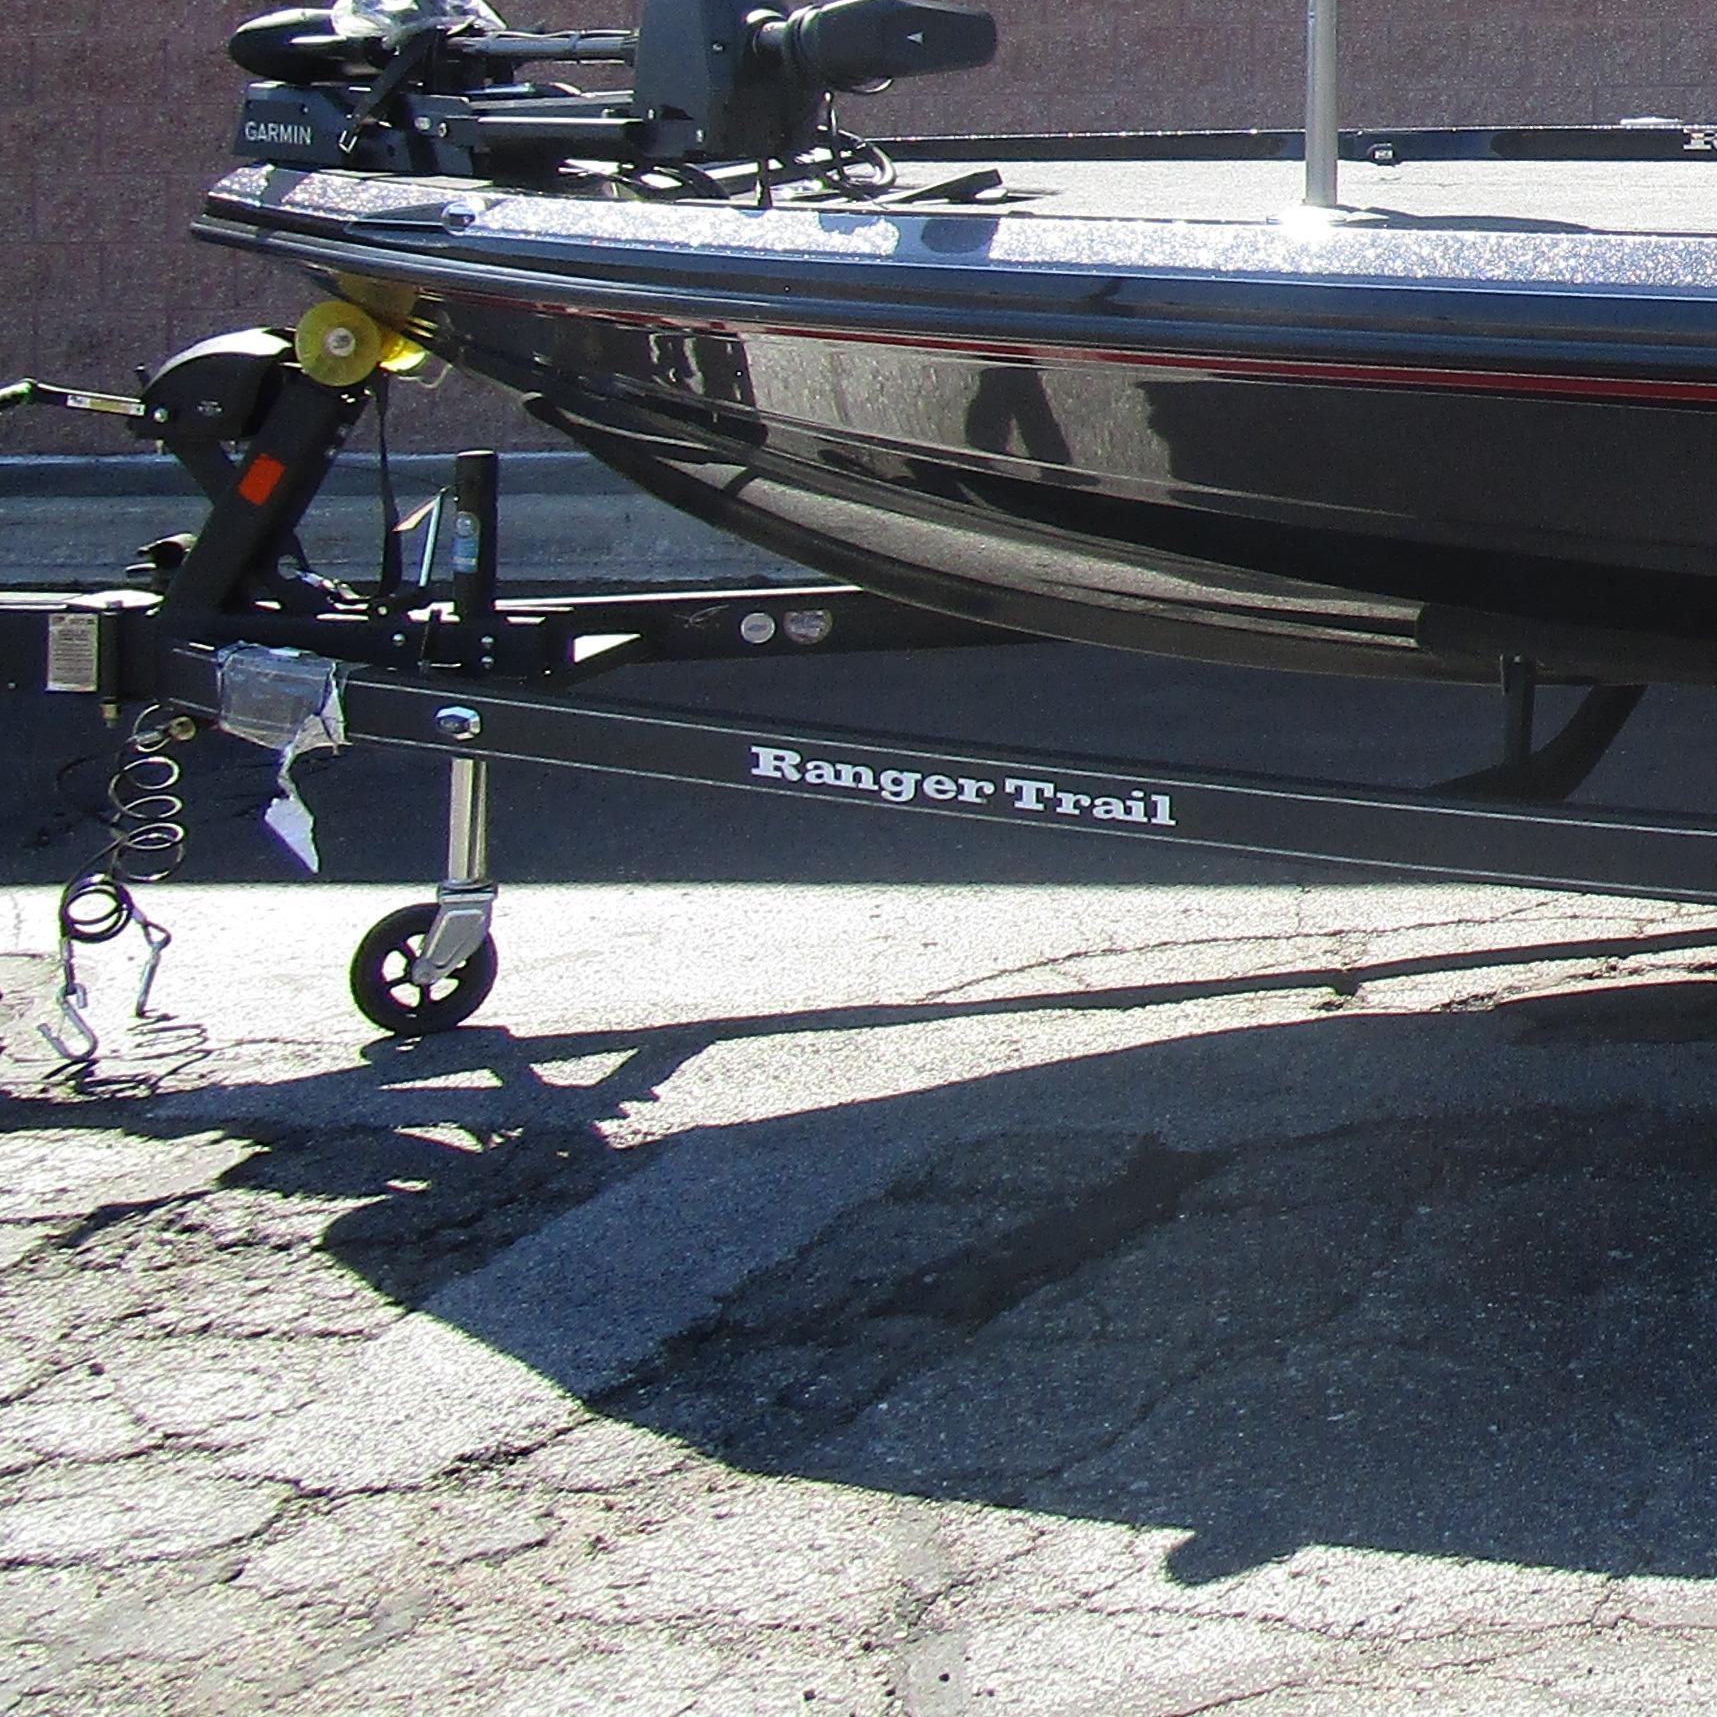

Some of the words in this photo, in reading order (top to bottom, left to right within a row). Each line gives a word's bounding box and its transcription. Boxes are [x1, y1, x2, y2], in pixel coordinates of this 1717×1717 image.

[244, 120, 312, 147] GARMIN
[749, 744, 996, 803] Ranger
[1004, 777, 1178, 827] Trail
